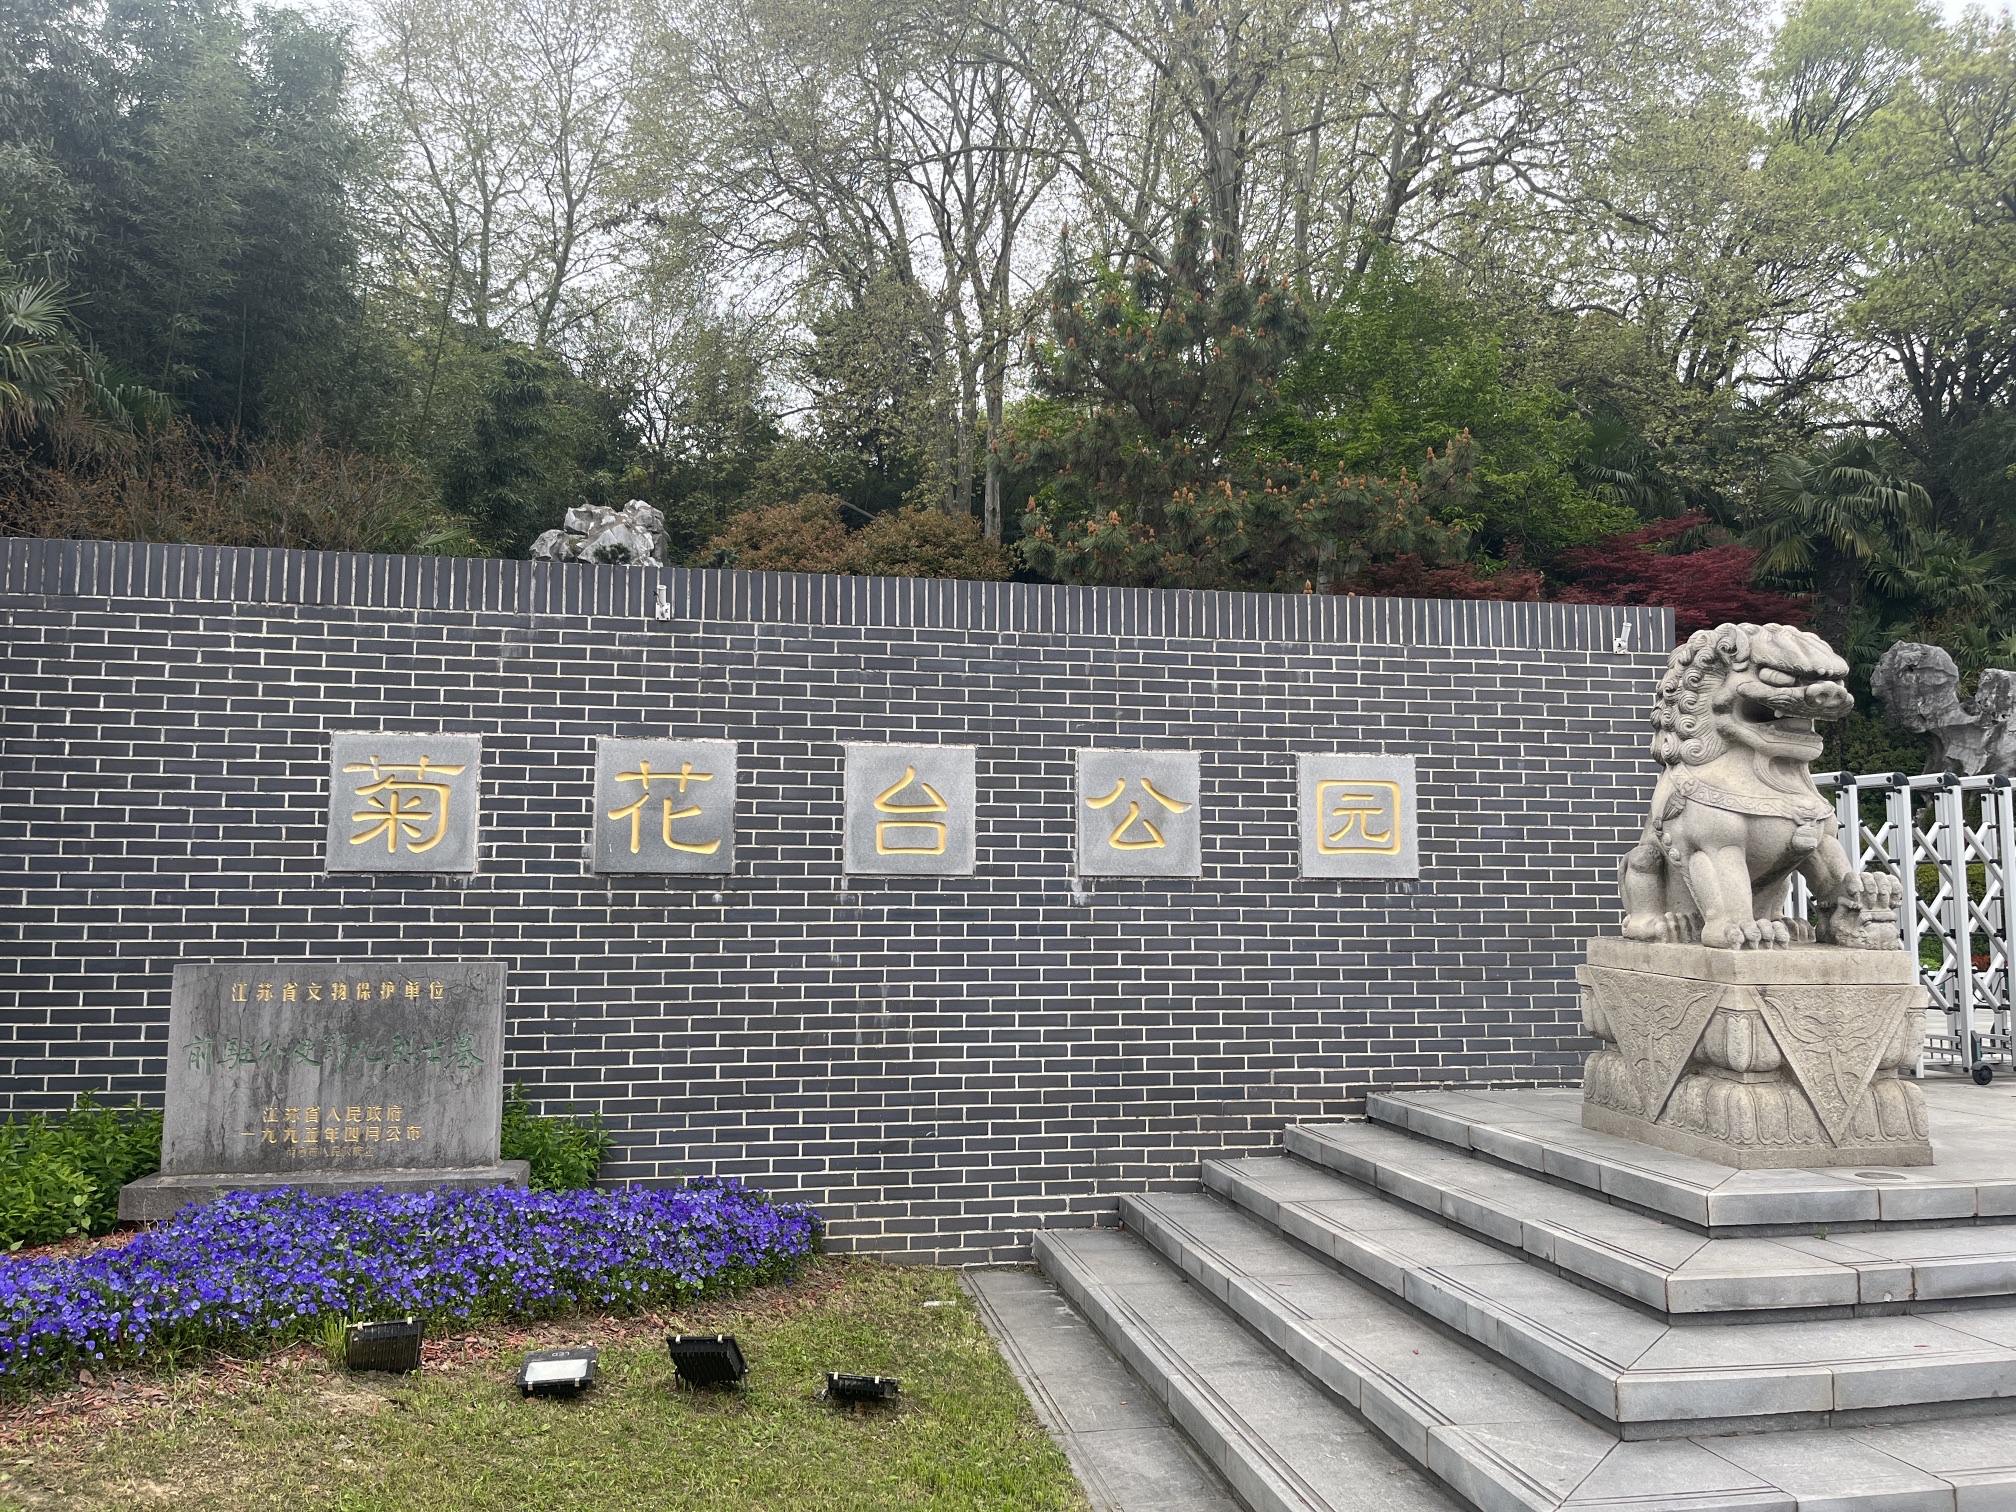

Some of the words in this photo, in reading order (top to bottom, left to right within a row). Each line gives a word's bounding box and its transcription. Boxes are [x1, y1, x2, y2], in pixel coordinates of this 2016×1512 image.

[342, 754, 1401, 856] 菊花台公园
[231, 980, 446, 1002] 江苏省文物保护单位
[262, 1105, 404, 1123] 江苏省人民政府
[240, 1125, 423, 1144] 一九九五年四月公布
